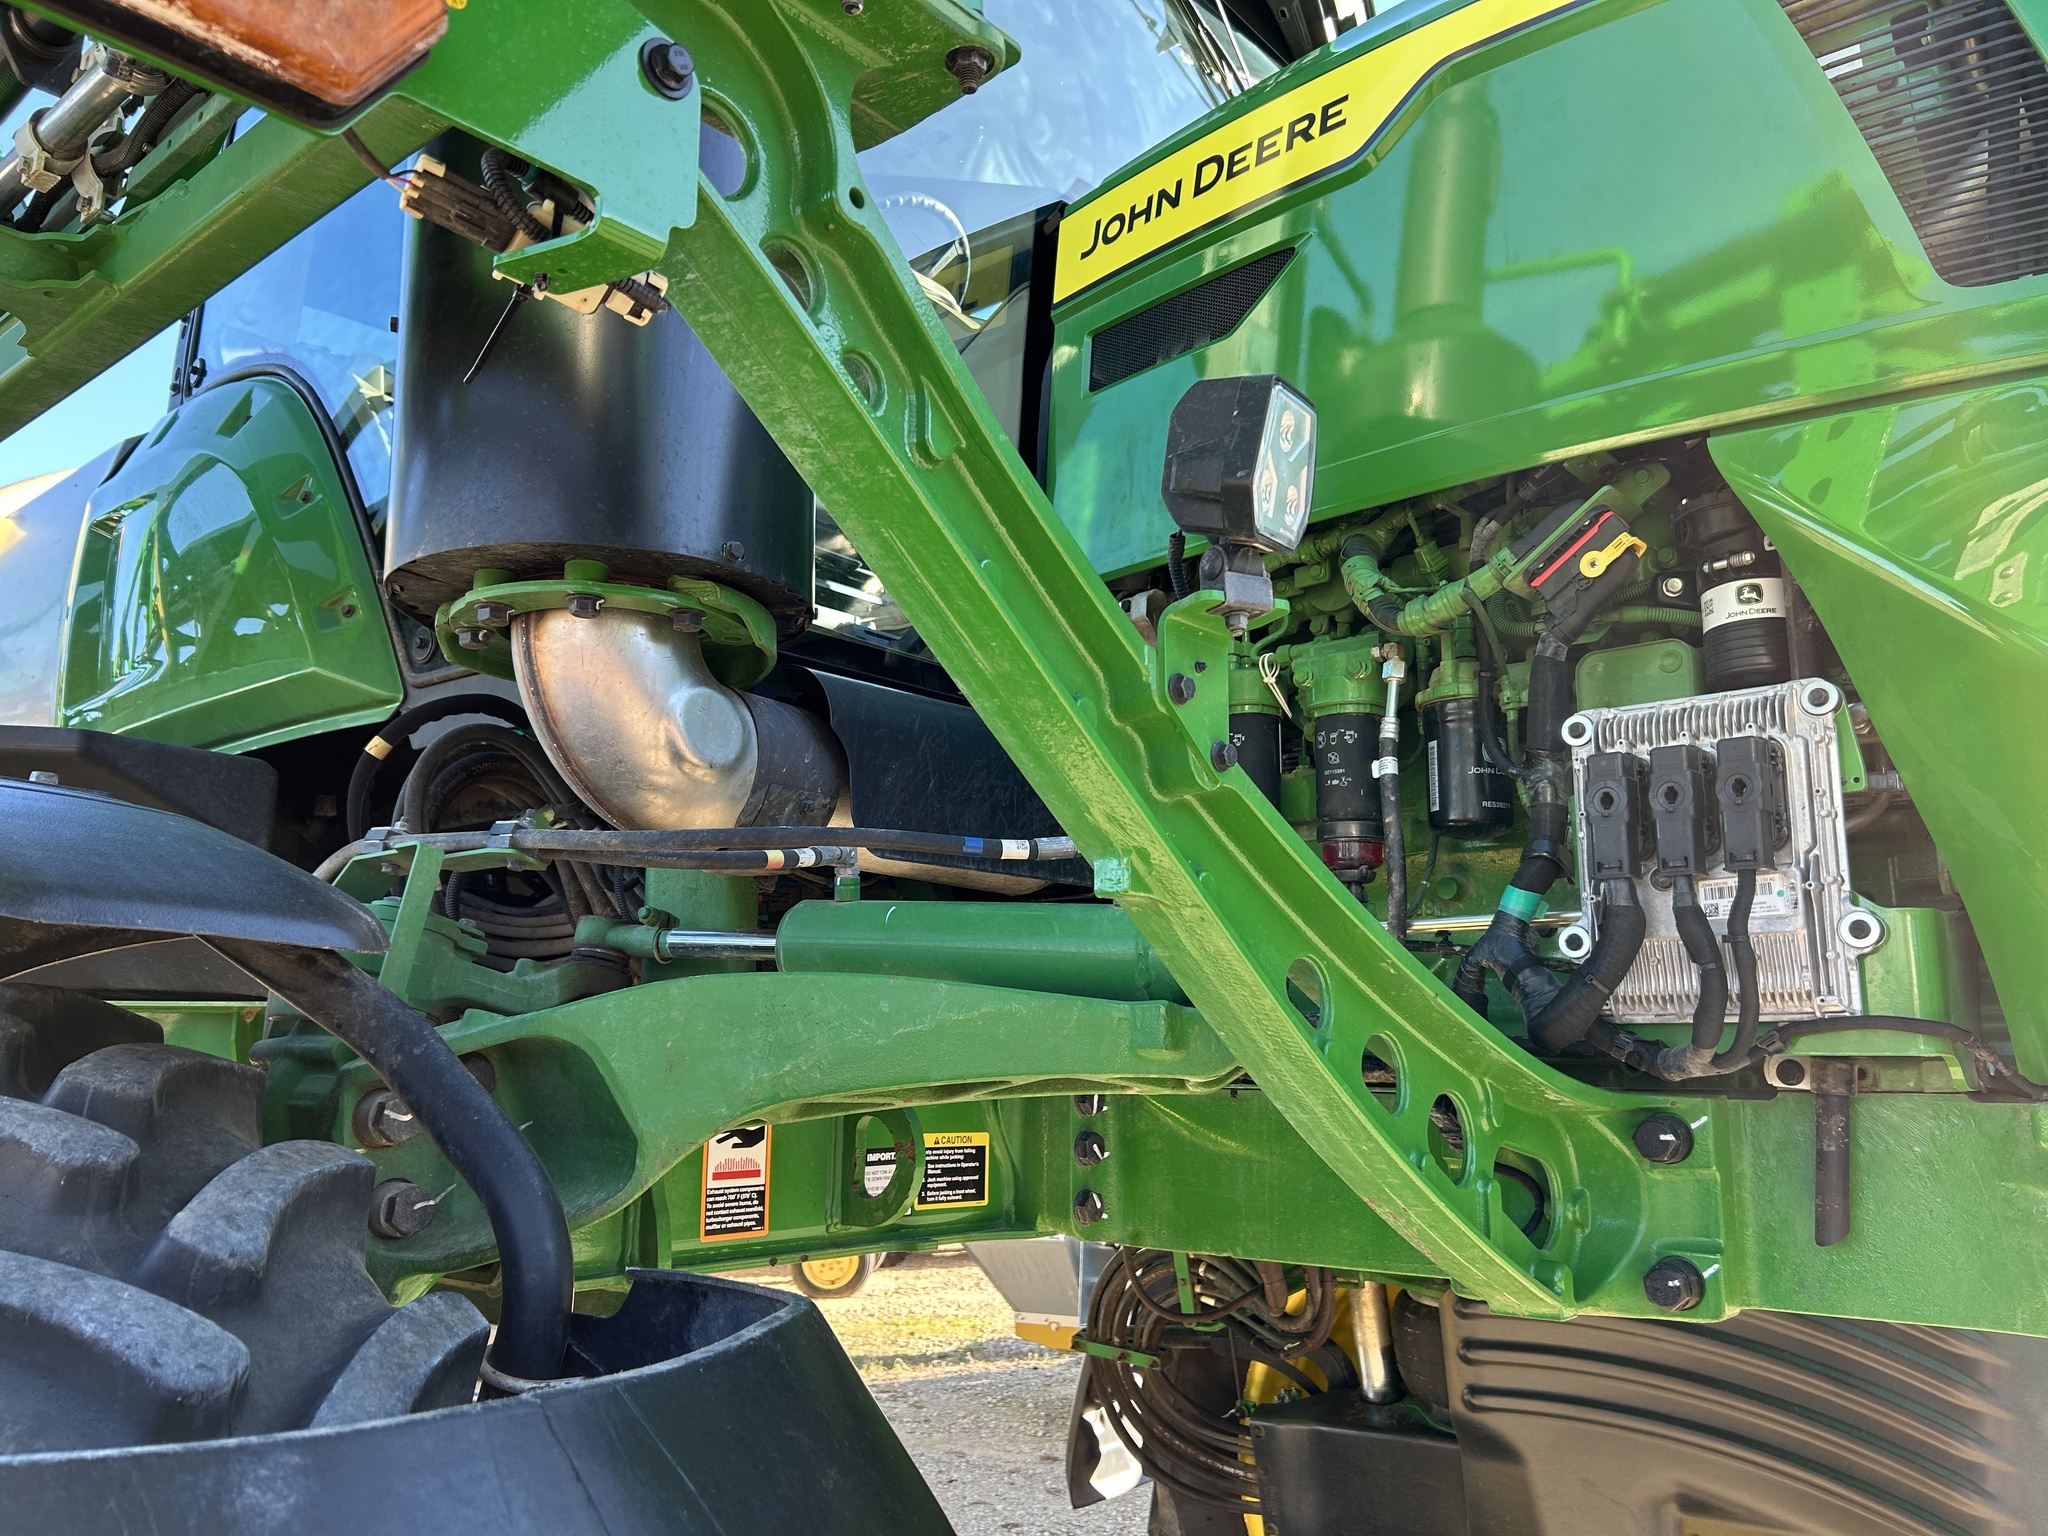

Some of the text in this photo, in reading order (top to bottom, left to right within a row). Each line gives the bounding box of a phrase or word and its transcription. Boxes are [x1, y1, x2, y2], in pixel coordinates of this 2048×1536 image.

[1080, 94, 1349, 260] JOHN DEERE
[1726, 609, 1747, 619] JOHN
[1468, 766, 1494, 774] JOHN
[941, 1136, 973, 1145] CAUTION
[867, 1152, 896, 1162] IMPORT
